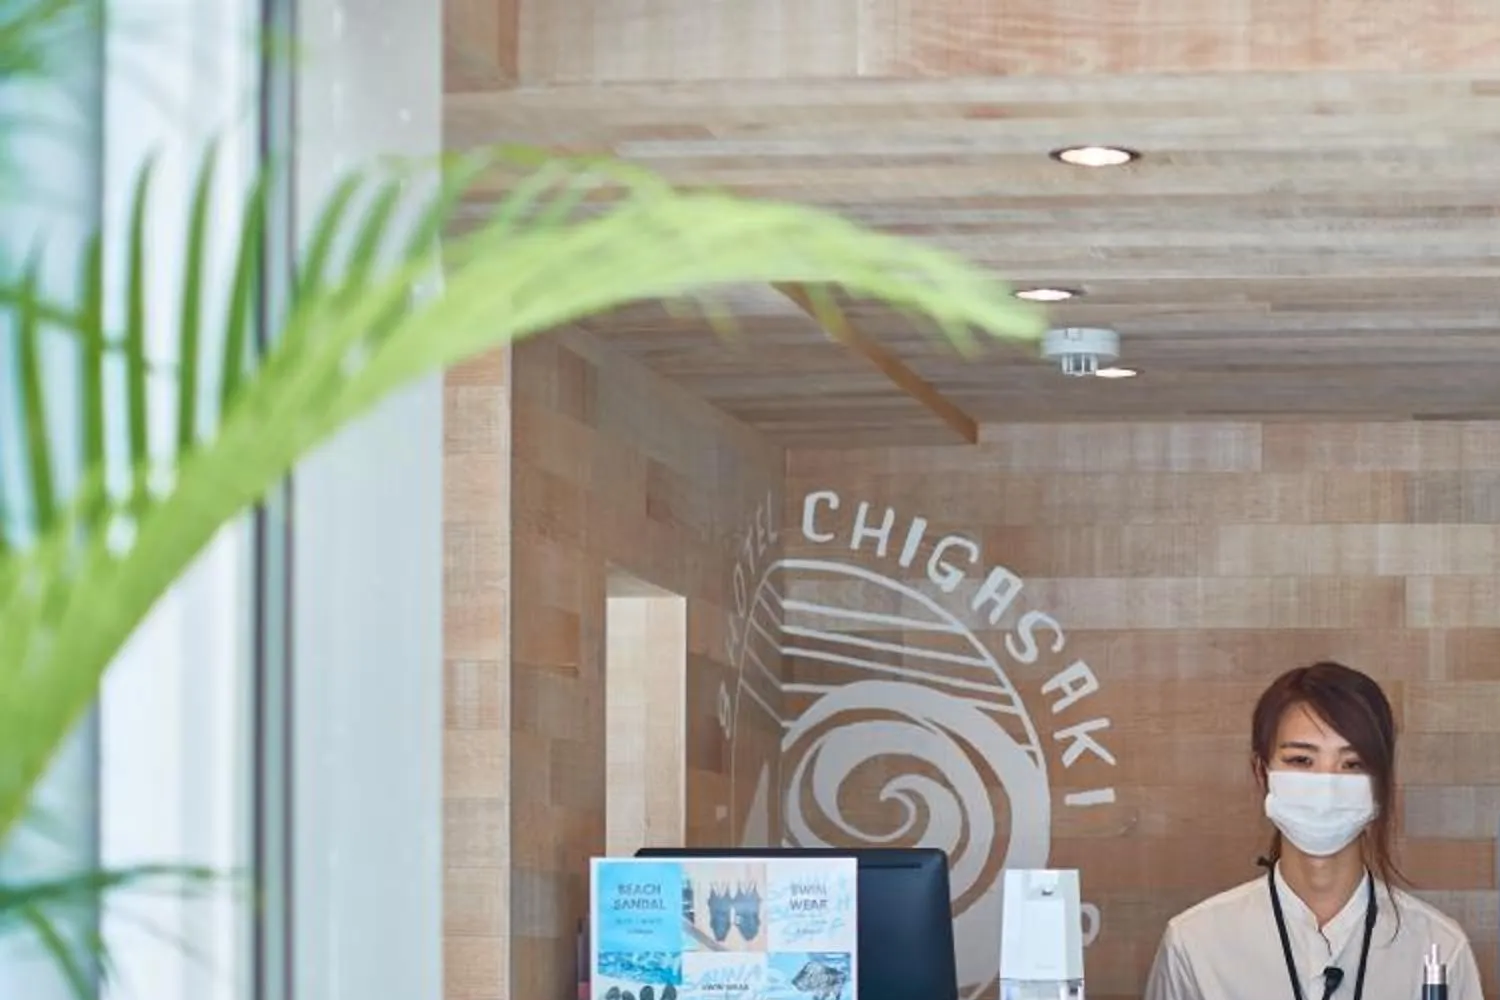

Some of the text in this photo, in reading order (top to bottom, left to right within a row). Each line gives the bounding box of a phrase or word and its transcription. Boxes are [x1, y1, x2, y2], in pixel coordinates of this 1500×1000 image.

[726, 490, 778, 667] HOTEL
[803, 491, 1117, 807] CHIGASAKI
[617, 884, 662, 895] BEACH
[613, 899, 666, 910] SANDAL
[789, 899, 829, 911] WEAR
